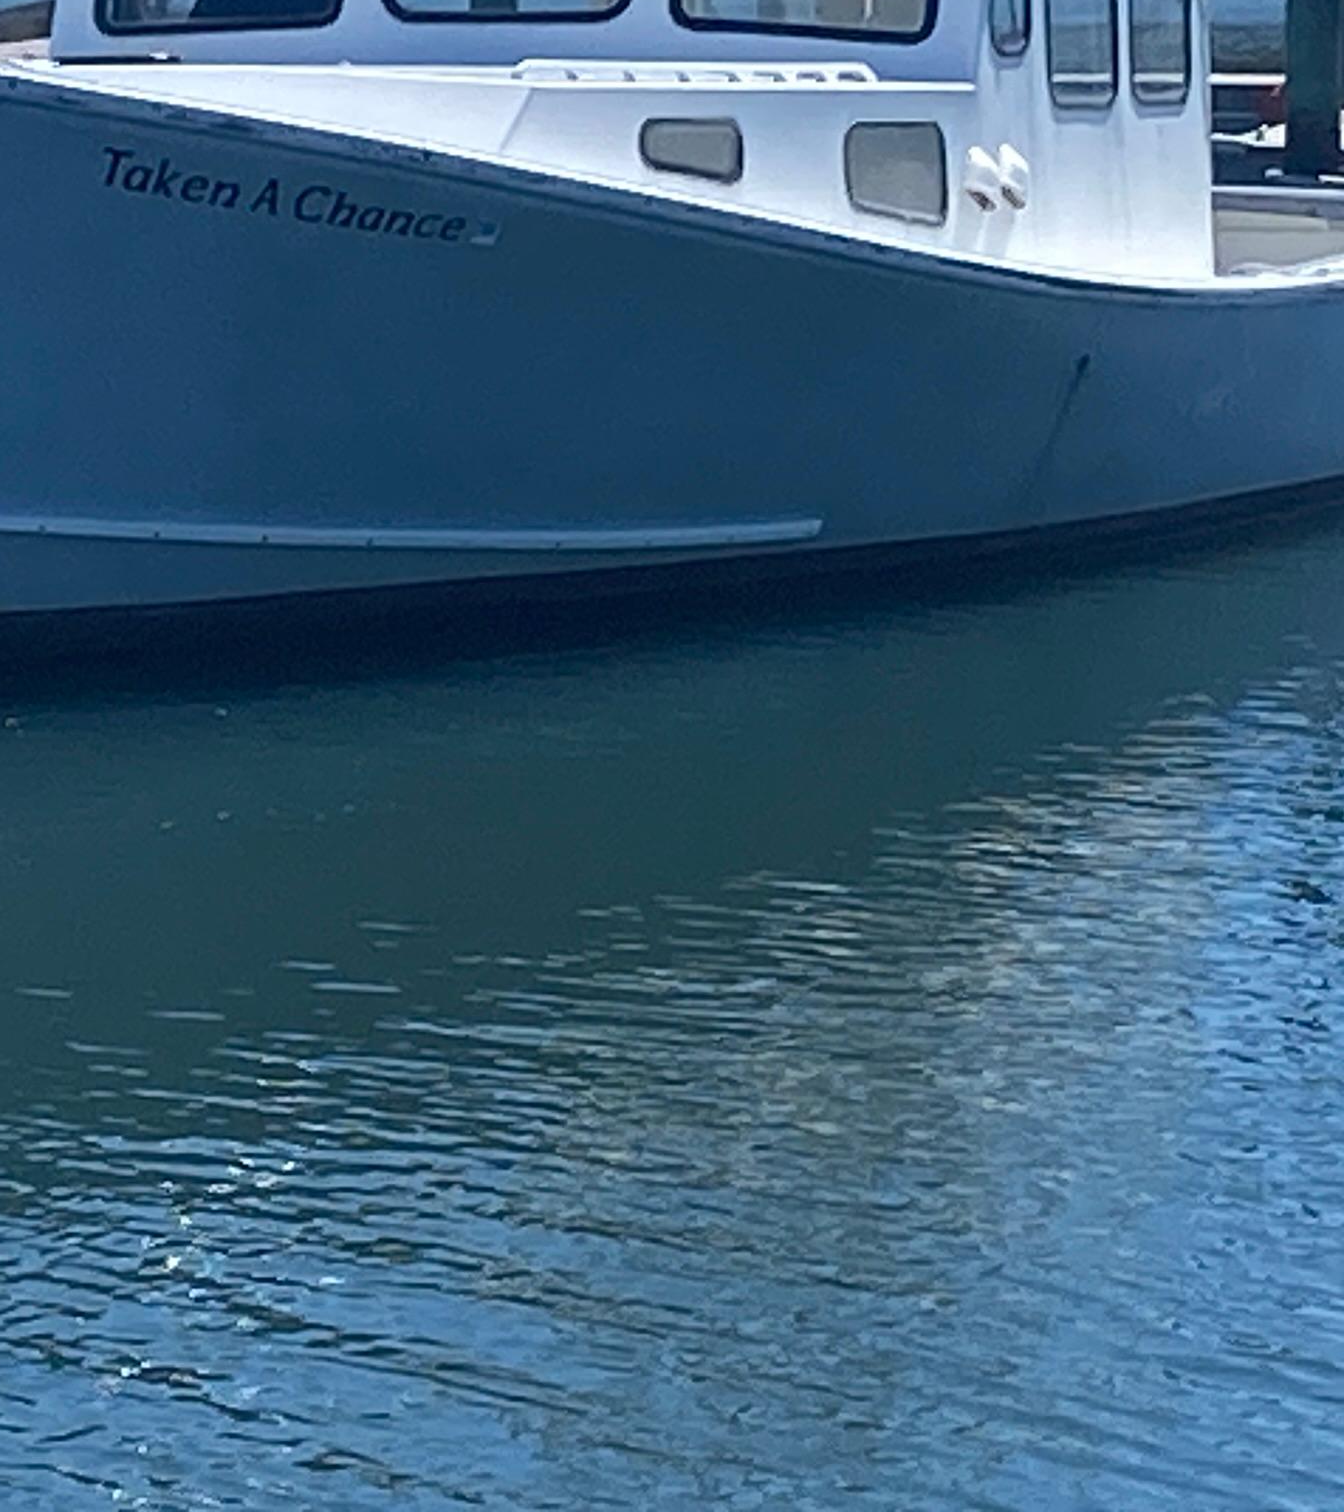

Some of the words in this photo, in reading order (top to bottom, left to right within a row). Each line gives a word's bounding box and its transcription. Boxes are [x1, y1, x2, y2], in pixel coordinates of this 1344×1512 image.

[102, 146, 240, 209] Taken
[250, 178, 280, 216] A
[293, 185, 467, 242] Chance
